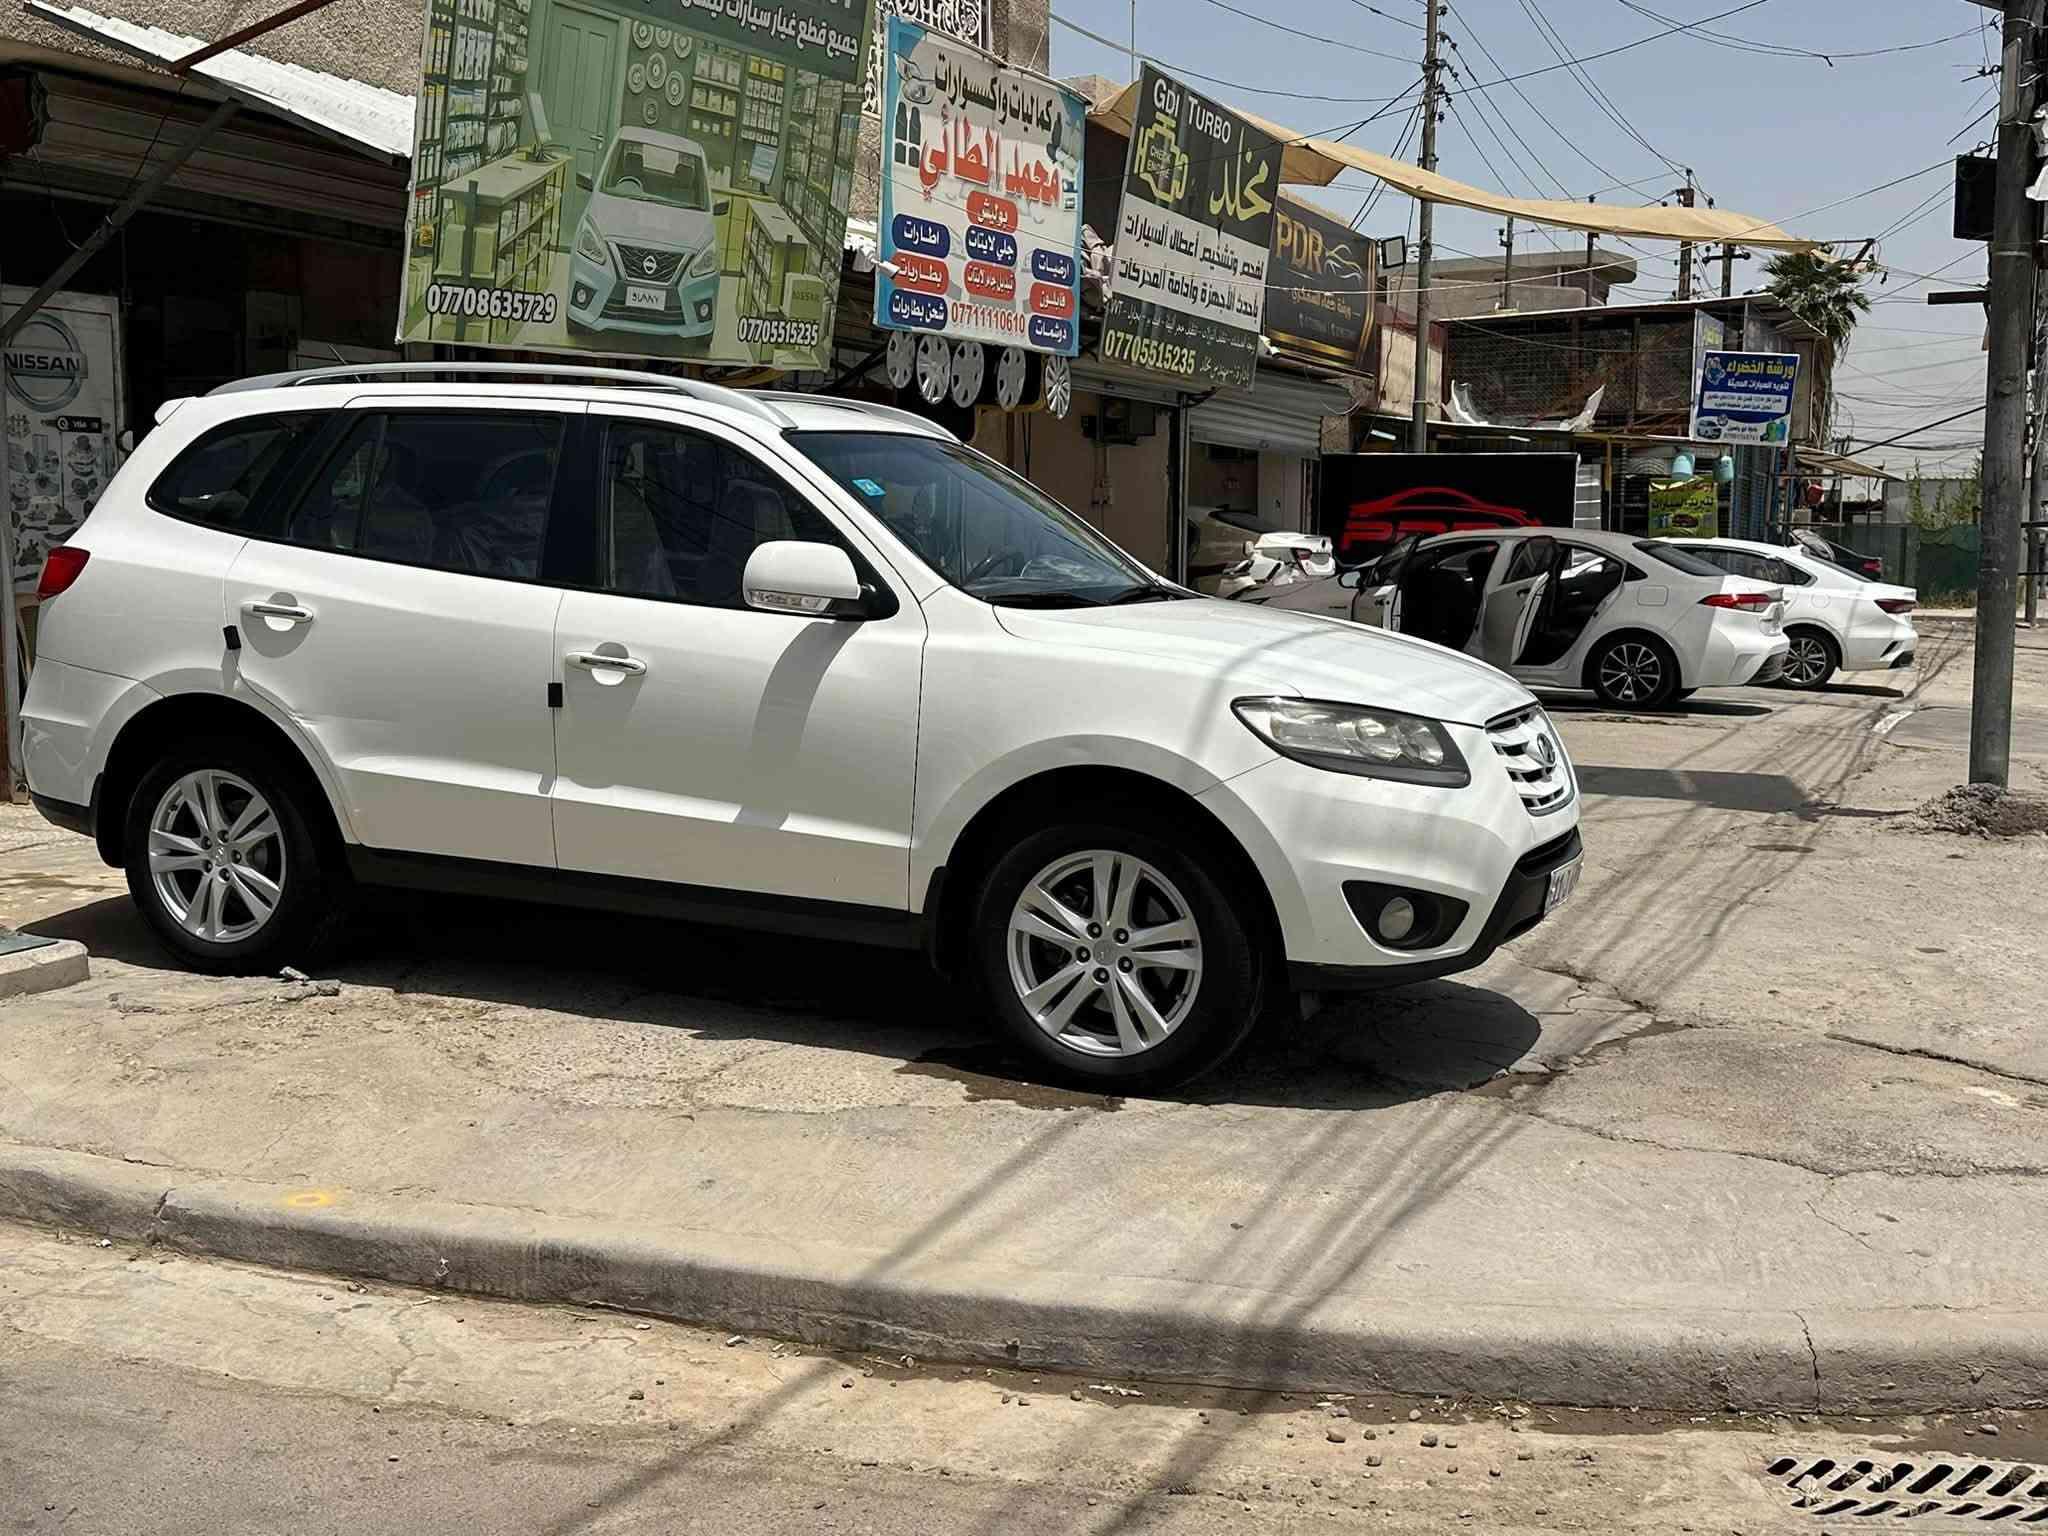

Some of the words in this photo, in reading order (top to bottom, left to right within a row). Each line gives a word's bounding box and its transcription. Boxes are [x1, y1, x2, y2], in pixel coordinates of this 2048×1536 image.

[770, 8, 797, 39] غيار
[796, 18, 827, 50] قطع
[827, 29, 859, 61] جميع
[1009, 84, 1053, 132] كماليات
[1153, 78, 1181, 118] GDI
[1187, 95, 1231, 144] TURBO
[919, 103, 1000, 201] الطائي
[1005, 143, 1060, 206] محمد
[1124, 213, 1169, 248] السيارات
[1276, 212, 1323, 273] PDR
[427, 283, 557, 322] 07708635729
[892, 294, 925, 322] بطاريات
[925, 301, 945, 323] شحن
[951, 302, 1026, 334] 07711110610
[738, 316, 820, 347] 07705515235
[4, 352, 80, 372] NISSAN
[1104, 328, 1197, 375] 07705515235
[1726, 359, 1764, 377] الخضراء
[1766, 359, 1795, 379] ورشة
